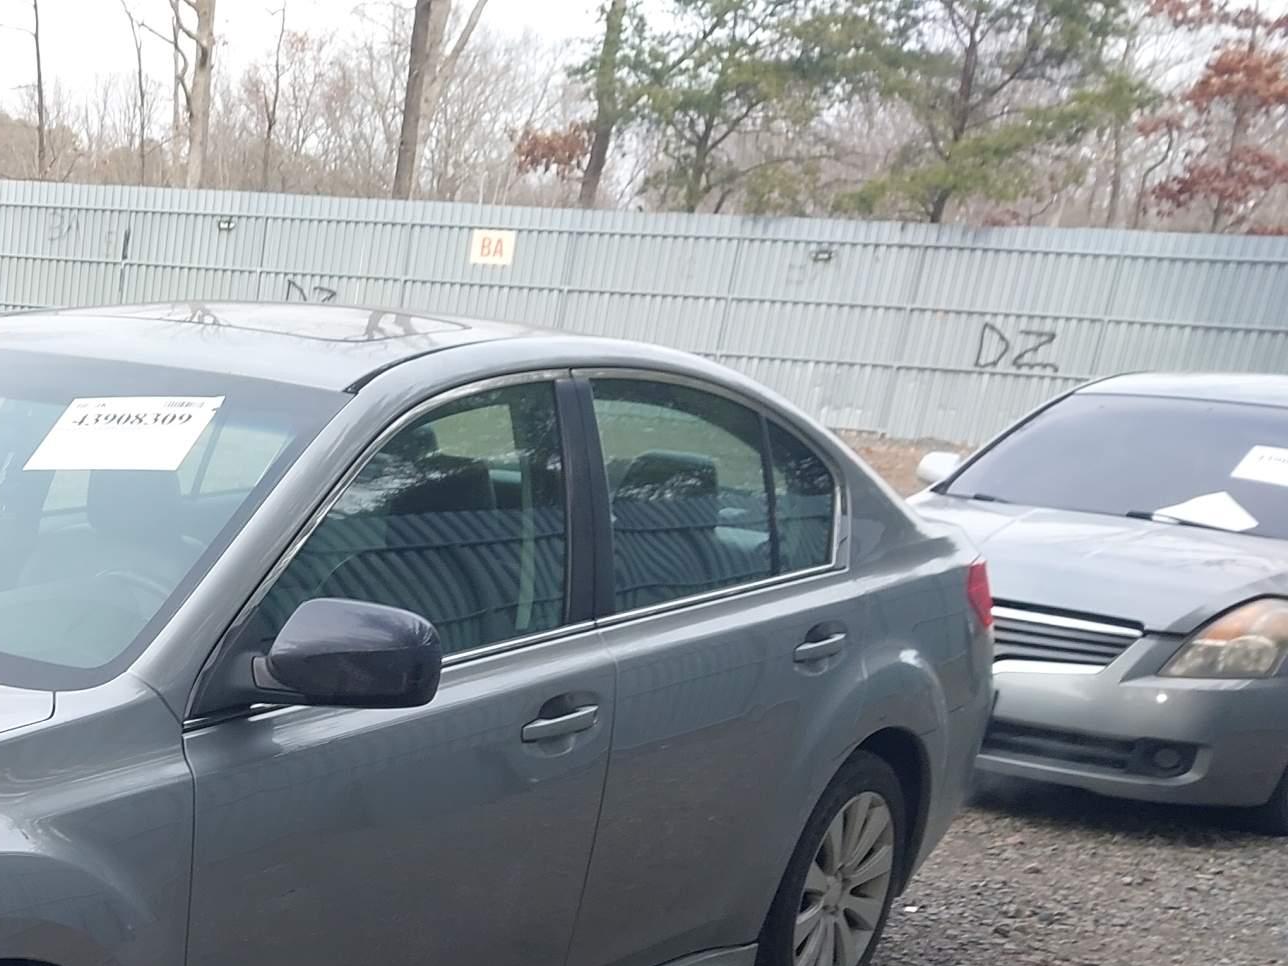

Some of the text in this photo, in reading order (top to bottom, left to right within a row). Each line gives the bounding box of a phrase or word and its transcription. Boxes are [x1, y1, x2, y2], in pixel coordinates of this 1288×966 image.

[480, 236, 504, 258] BA
[974, 322, 1059, 373] DZ
[72, 412, 194, 427] 43908309
